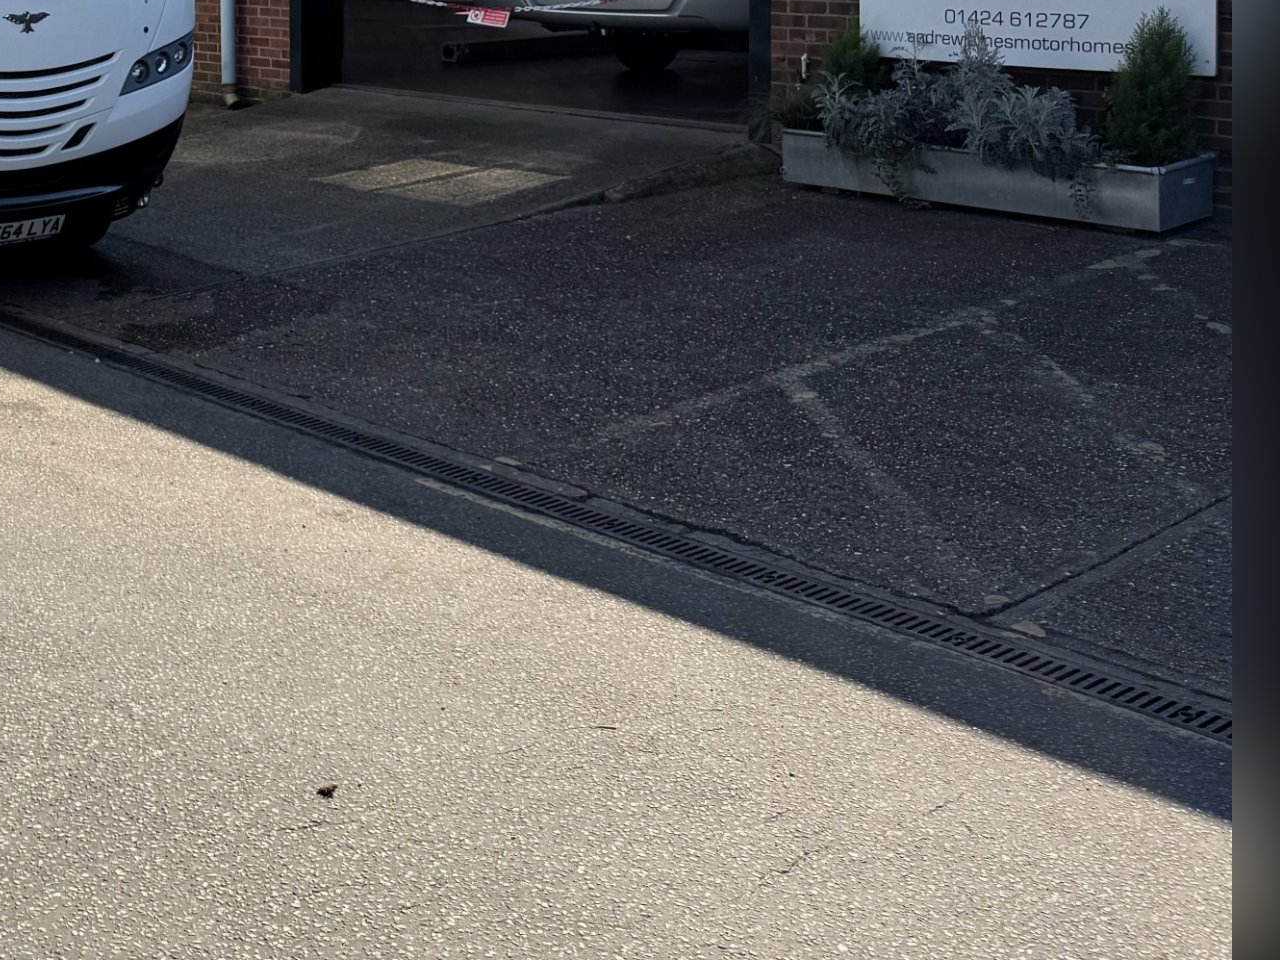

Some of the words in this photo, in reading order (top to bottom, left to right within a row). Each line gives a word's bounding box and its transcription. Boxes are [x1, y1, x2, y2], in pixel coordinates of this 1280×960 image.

[944, 8, 1004, 26] 01424
[1010, 11, 1090, 29] 612787
[26, 217, 61, 237] LYA
